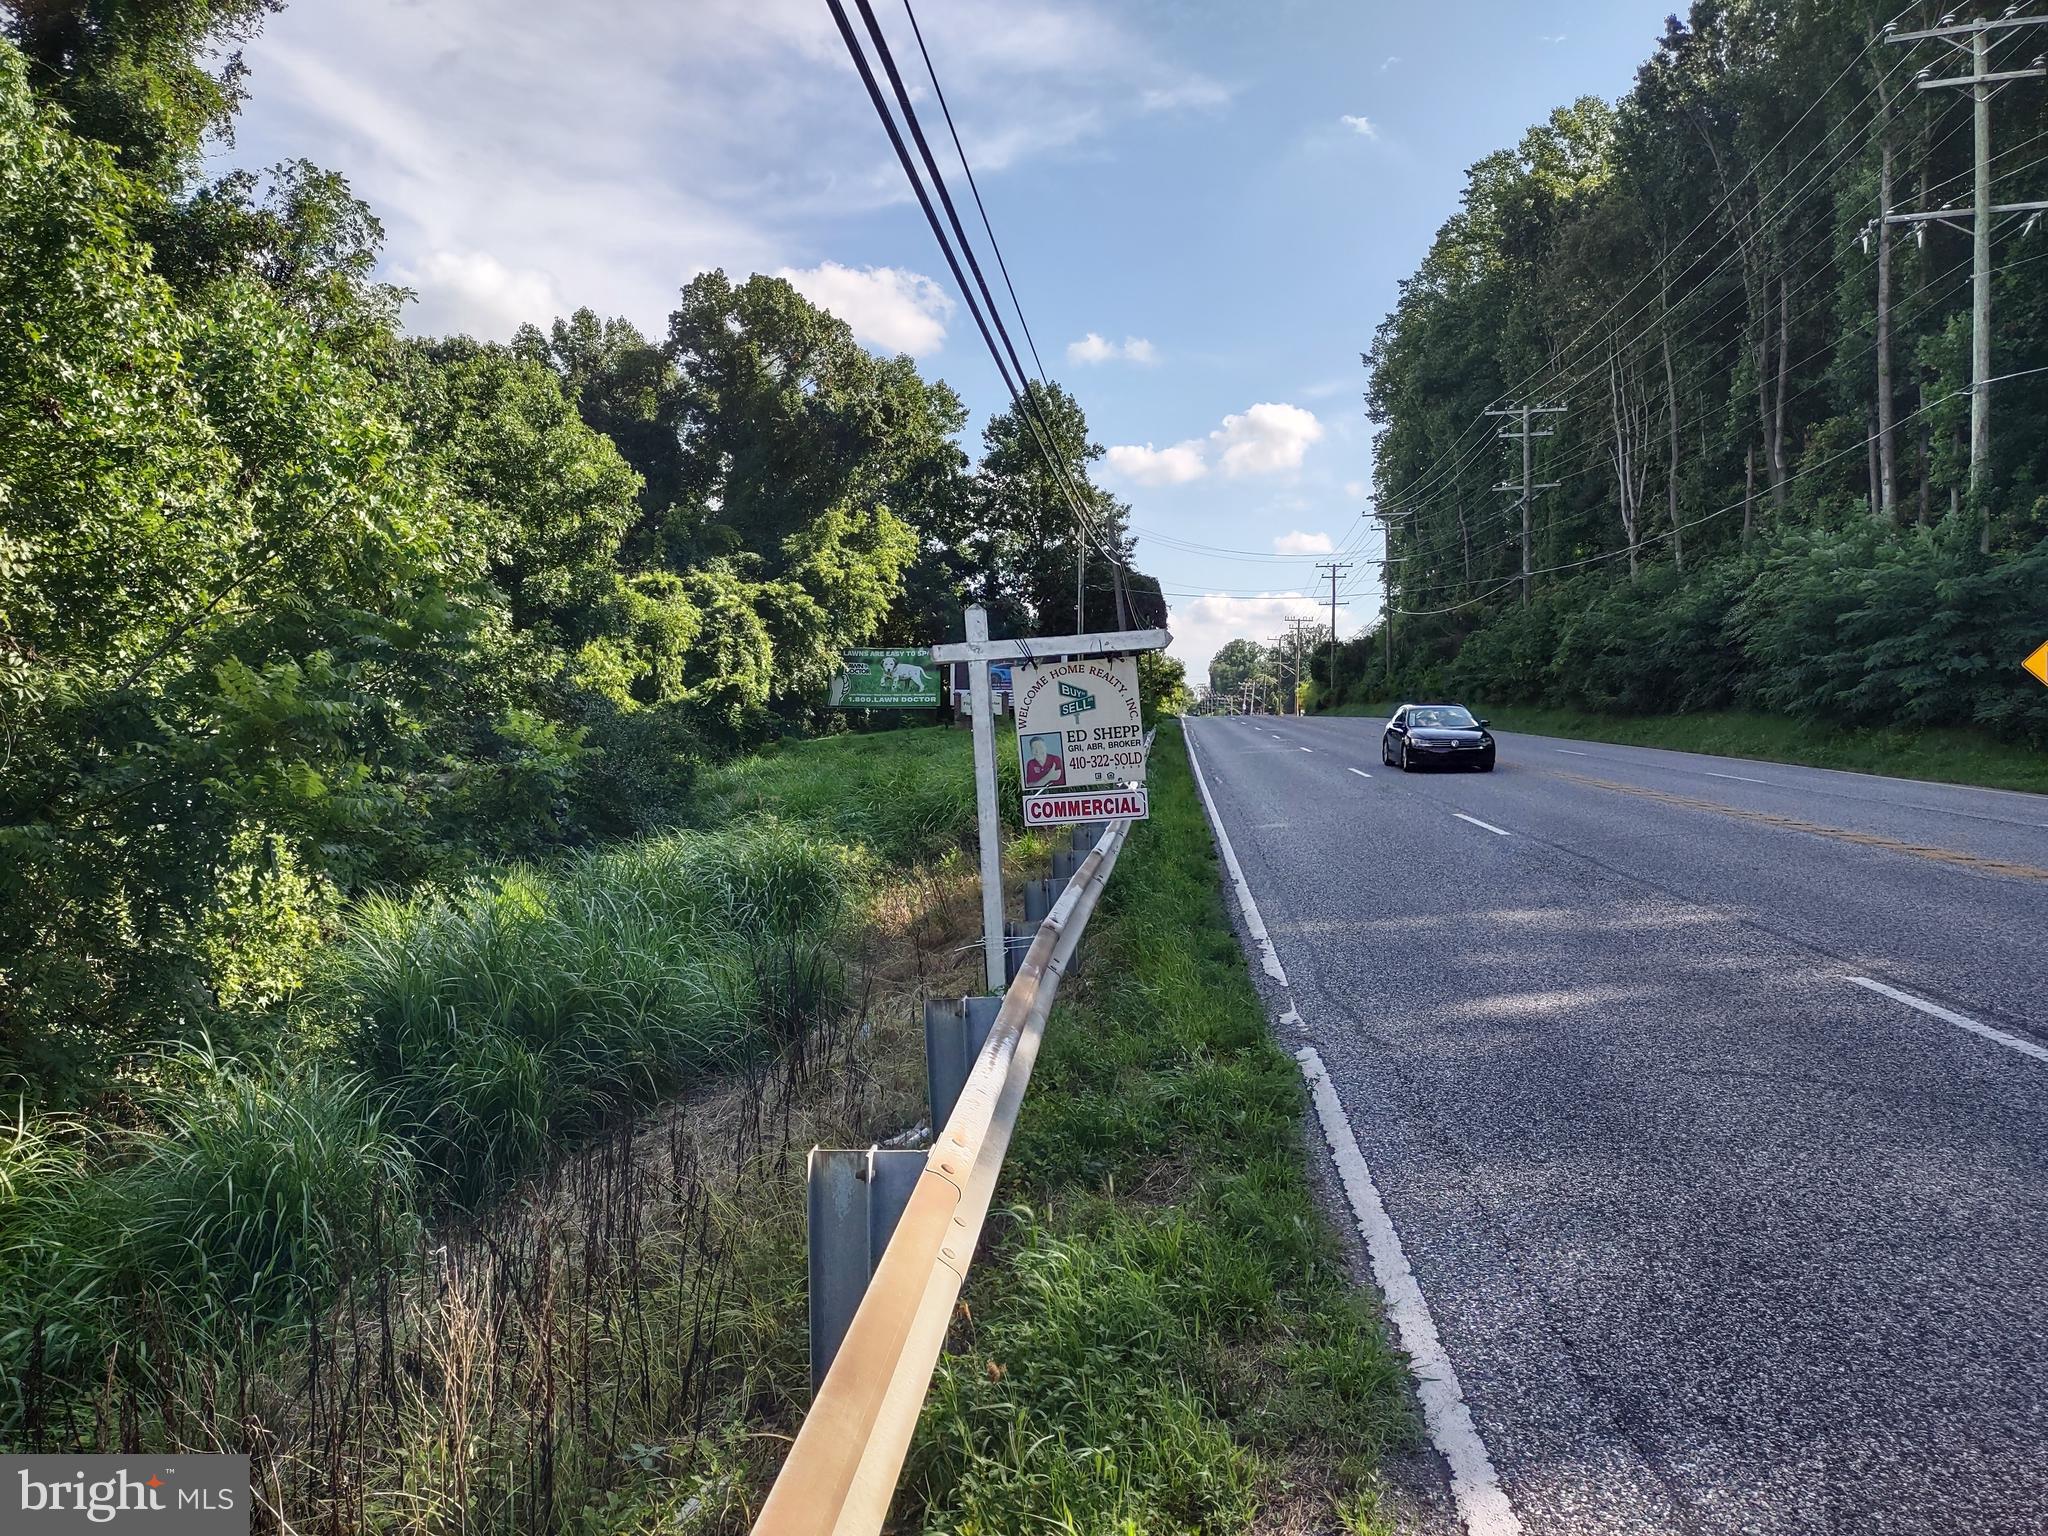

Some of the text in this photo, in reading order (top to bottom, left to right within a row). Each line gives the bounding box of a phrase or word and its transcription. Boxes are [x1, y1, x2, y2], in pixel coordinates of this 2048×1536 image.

[1018, 674, 1049, 730] WELCOME
[1049, 664, 1085, 680] HOME
[1125, 697, 1139, 721] INC.
[1061, 684, 1082, 698] BUY
[1062, 699, 1091, 715] SELL
[1066, 725, 1140, 743] ED SHEPP
[1068, 739, 1142, 753] GRI, ABR, BROKER
[1069, 751, 1143, 770] 410-322-SOLD
[1030, 797, 1141, 819] COMMERCIAL
